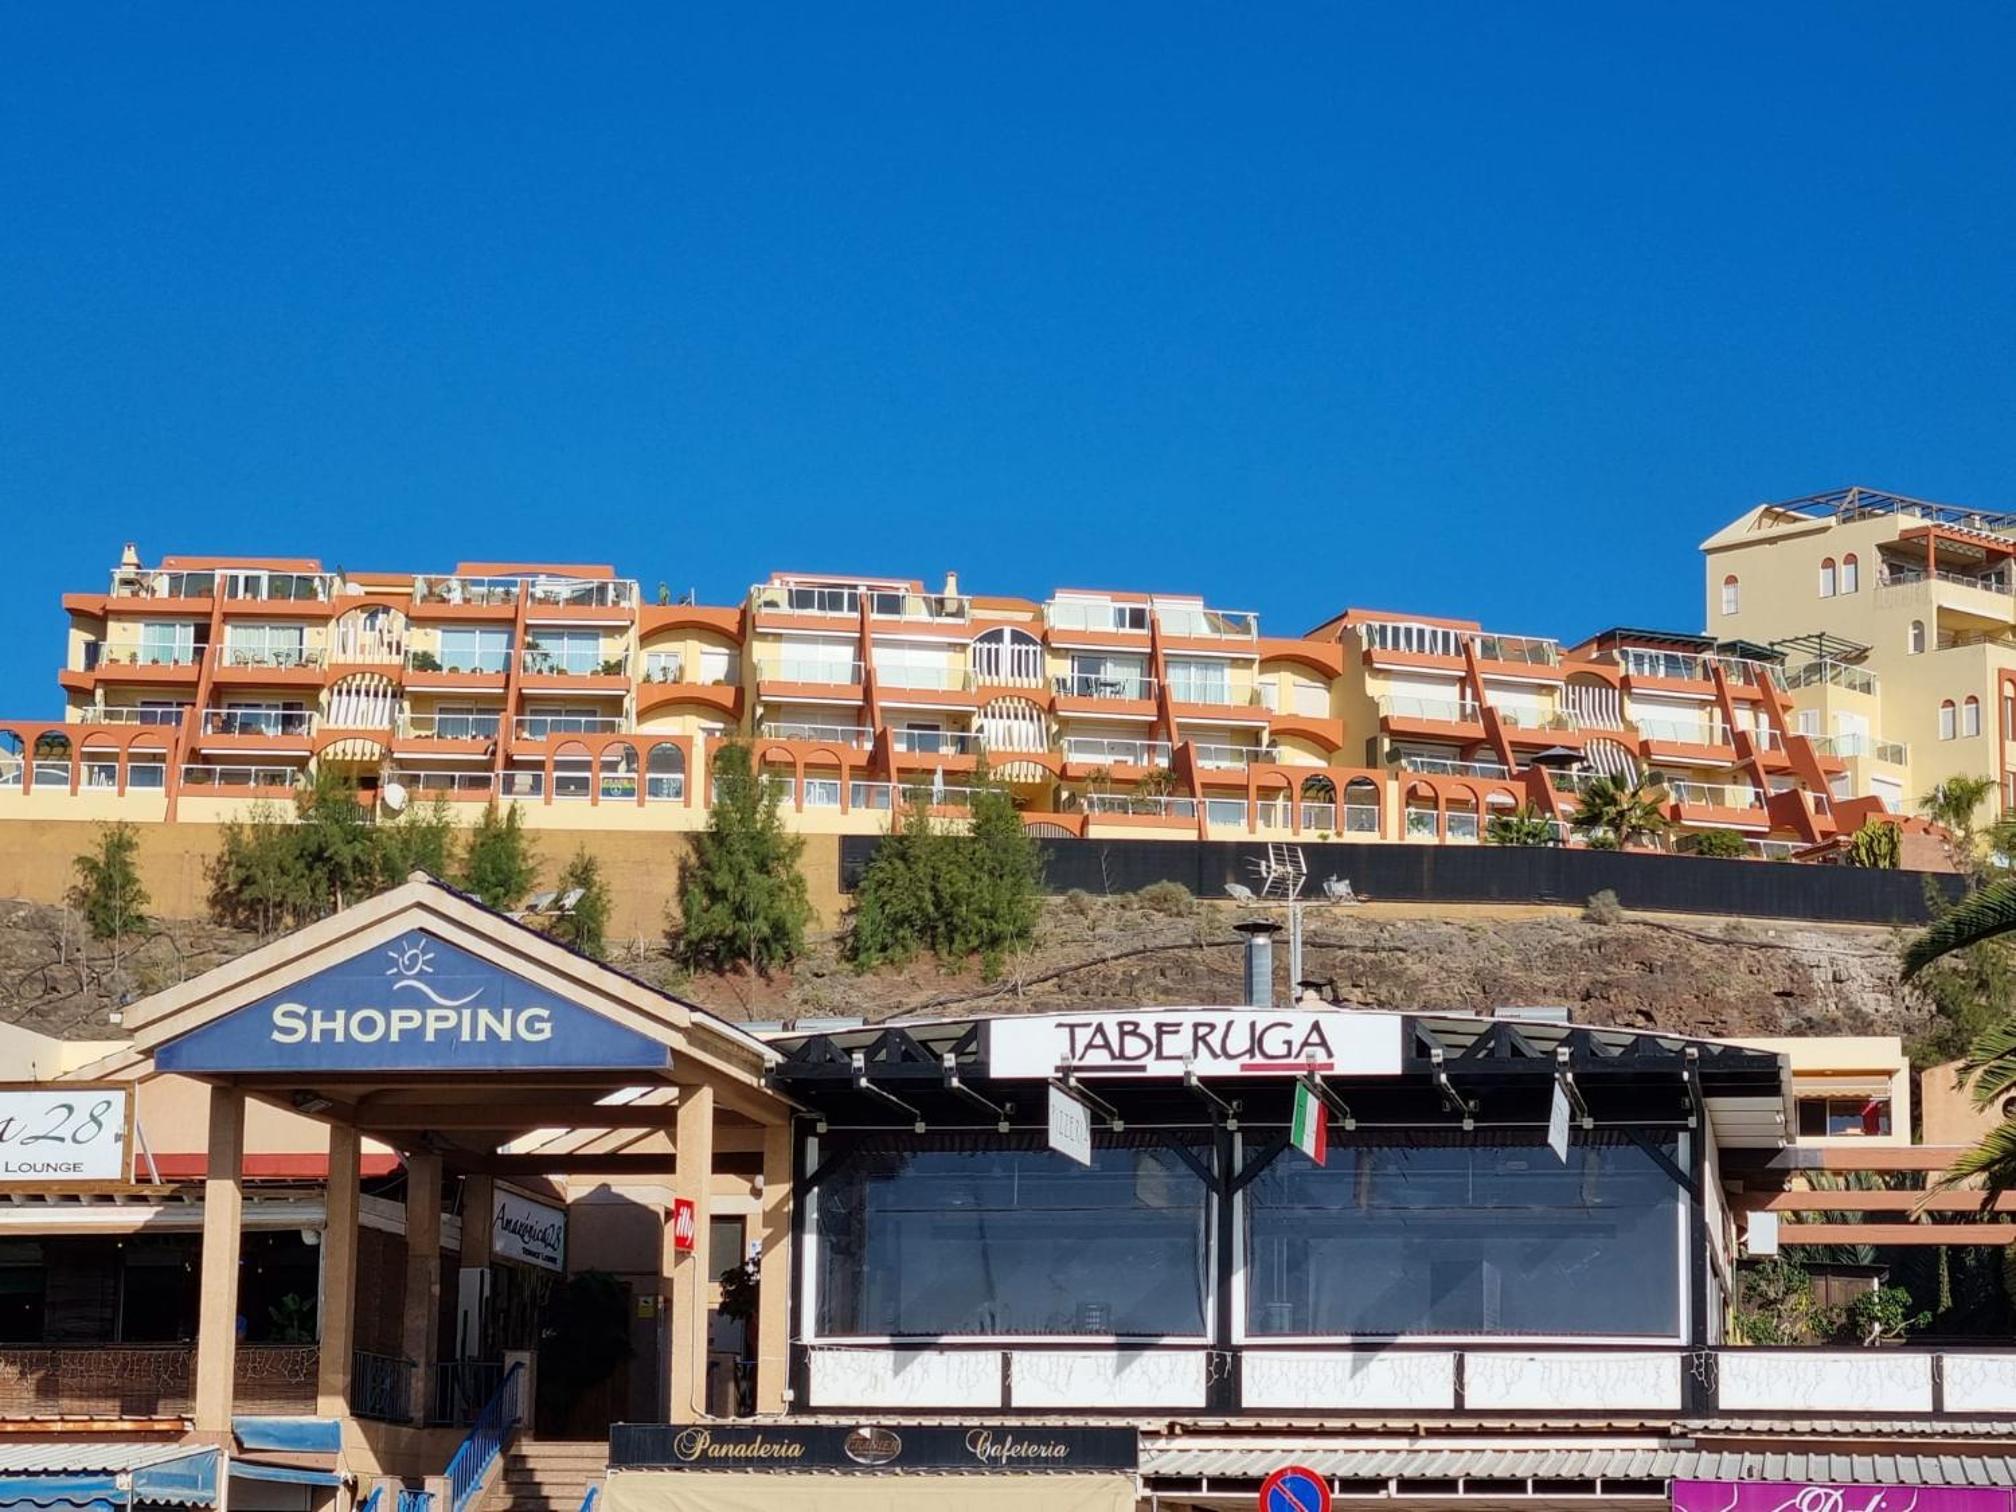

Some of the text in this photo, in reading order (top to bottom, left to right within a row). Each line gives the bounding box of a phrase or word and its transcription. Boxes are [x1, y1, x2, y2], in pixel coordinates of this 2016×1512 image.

[271, 1003, 553, 1043] SHOPPING
[1054, 1020, 1335, 1062] TABERUGA
[4, 1161, 84, 1173] LOUNGE
[676, 1206, 694, 1246] illy
[674, 1427, 806, 1461] Panaderia
[965, 1428, 1070, 1465] Cafeteria
